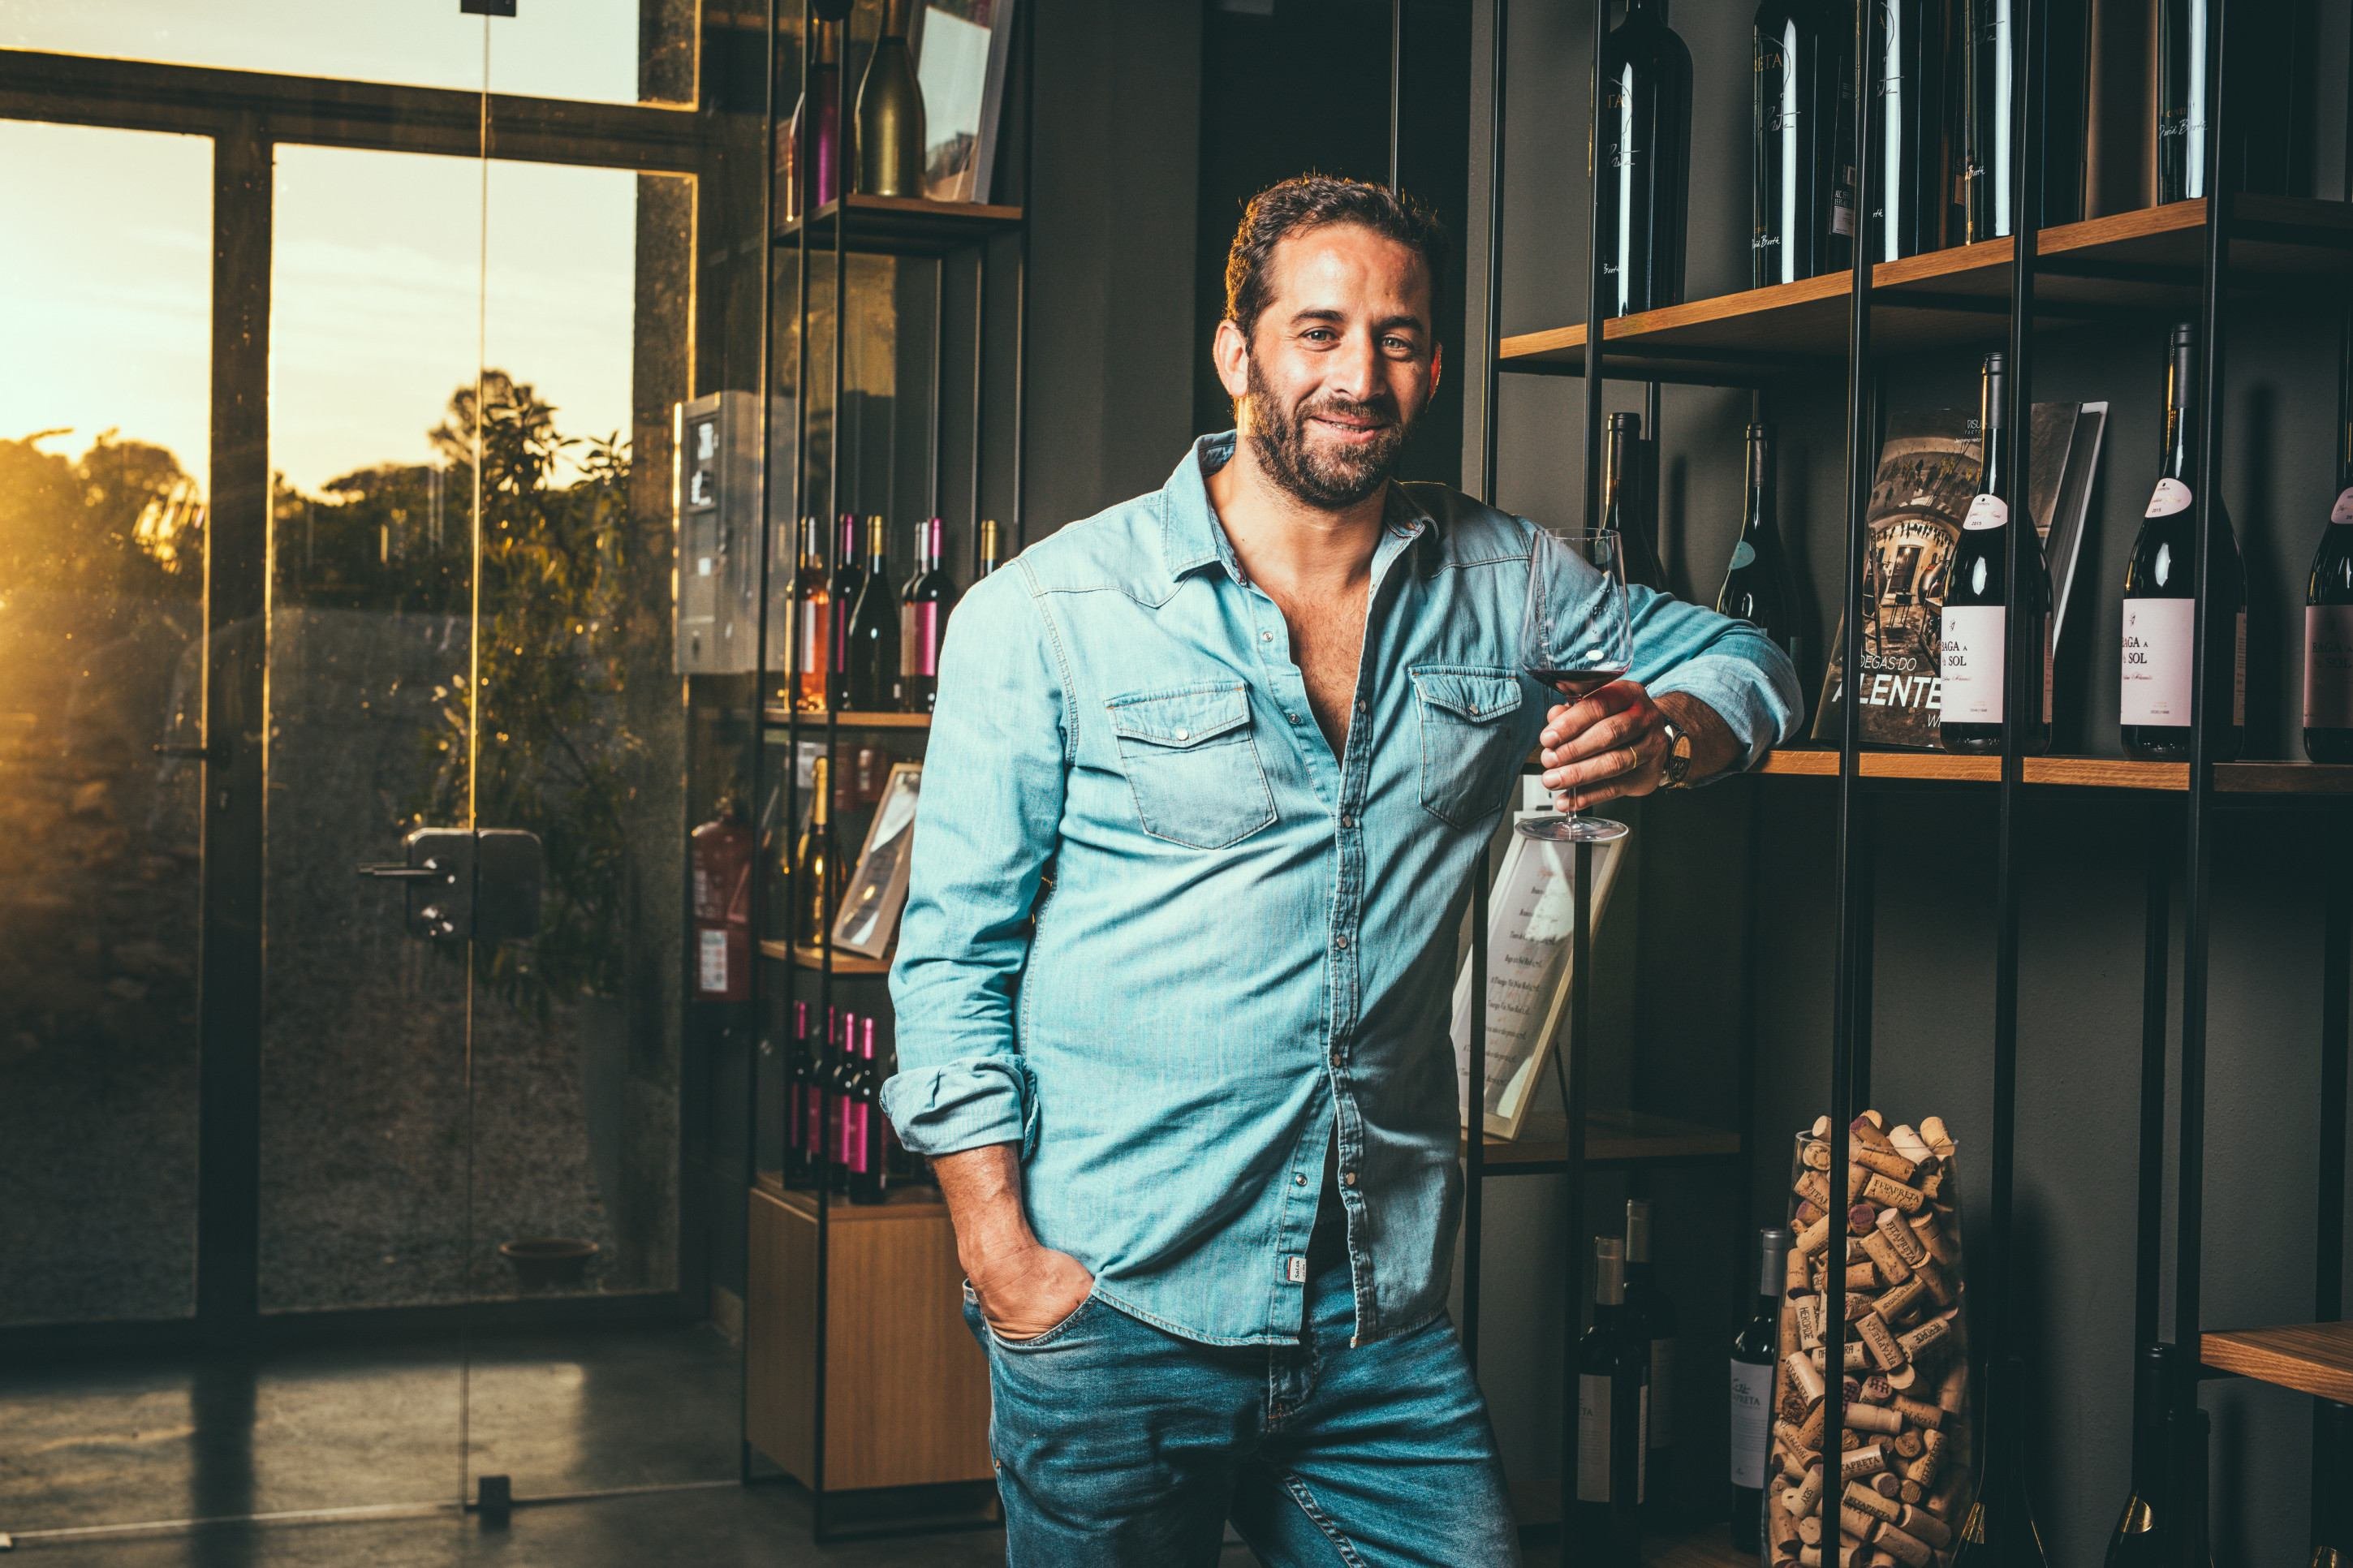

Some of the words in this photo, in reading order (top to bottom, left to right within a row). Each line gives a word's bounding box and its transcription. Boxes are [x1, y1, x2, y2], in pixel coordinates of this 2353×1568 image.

[1860, 654, 1895, 670] DEGAS
[1898, 657, 1917, 671] DO
[1948, 655, 1967, 666] SOL
[2128, 653, 2148, 664] SOL
[1873, 1179, 1920, 1203] FITAPRETA
[1886, 1220, 1916, 1262] FITAPRETA
[1866, 1320, 1898, 1365] FITAPRETA
[1786, 1359, 1809, 1402] FITAPRETA
